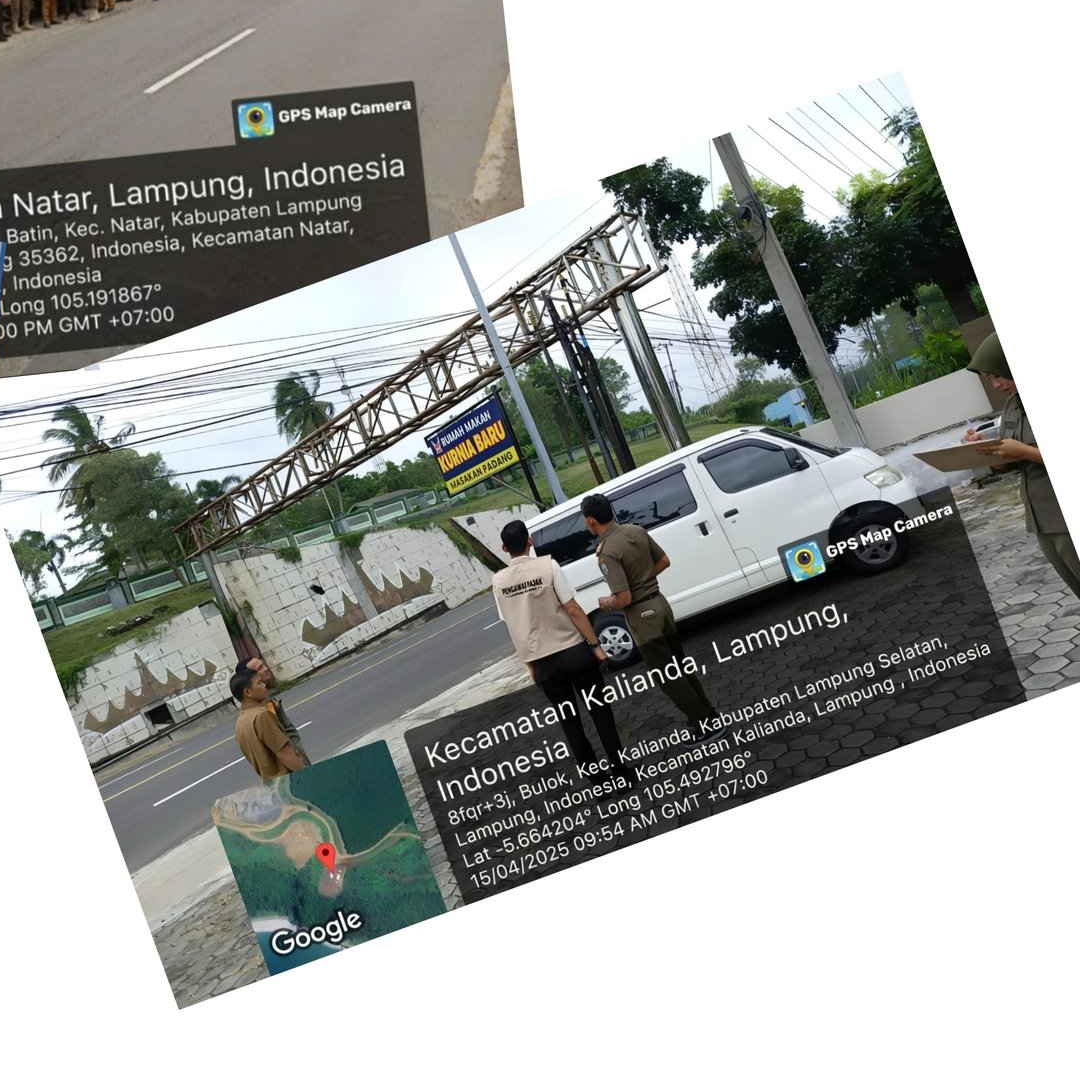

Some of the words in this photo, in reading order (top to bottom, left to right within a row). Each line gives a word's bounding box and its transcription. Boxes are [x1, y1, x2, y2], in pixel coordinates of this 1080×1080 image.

[437, 438, 478, 474] KURNIA
[472, 419, 507, 453] BARU
[440, 424, 465, 447] RUMAH
[465, 410, 491, 433] MAKAN
[450, 467, 483, 490] MASAKAN
[483, 450, 514, 473] PADANG
